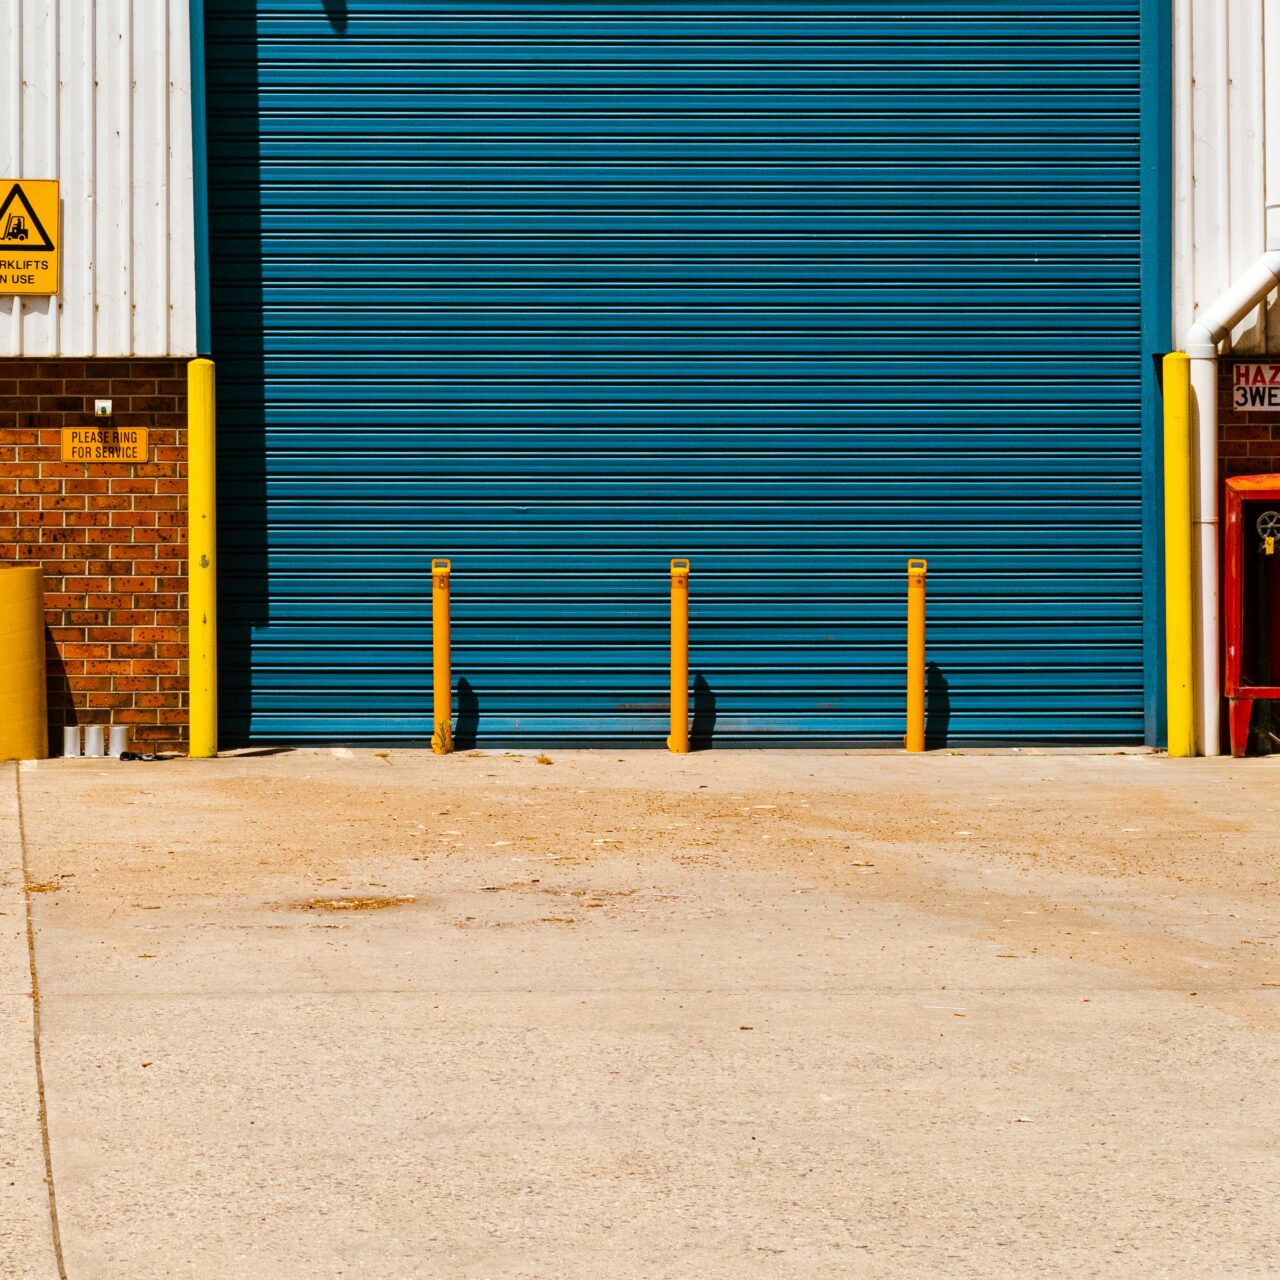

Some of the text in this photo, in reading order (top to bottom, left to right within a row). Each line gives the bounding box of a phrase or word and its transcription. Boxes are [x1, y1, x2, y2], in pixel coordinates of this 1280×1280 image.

[11, 274, 35, 284] USE
[1235, 365, 1280, 385] HAZ
[1235, 386, 1280, 407] 3WE
[71, 431, 137, 443] PLEASE RING
[71, 446, 138, 458] FOR SERVICE
